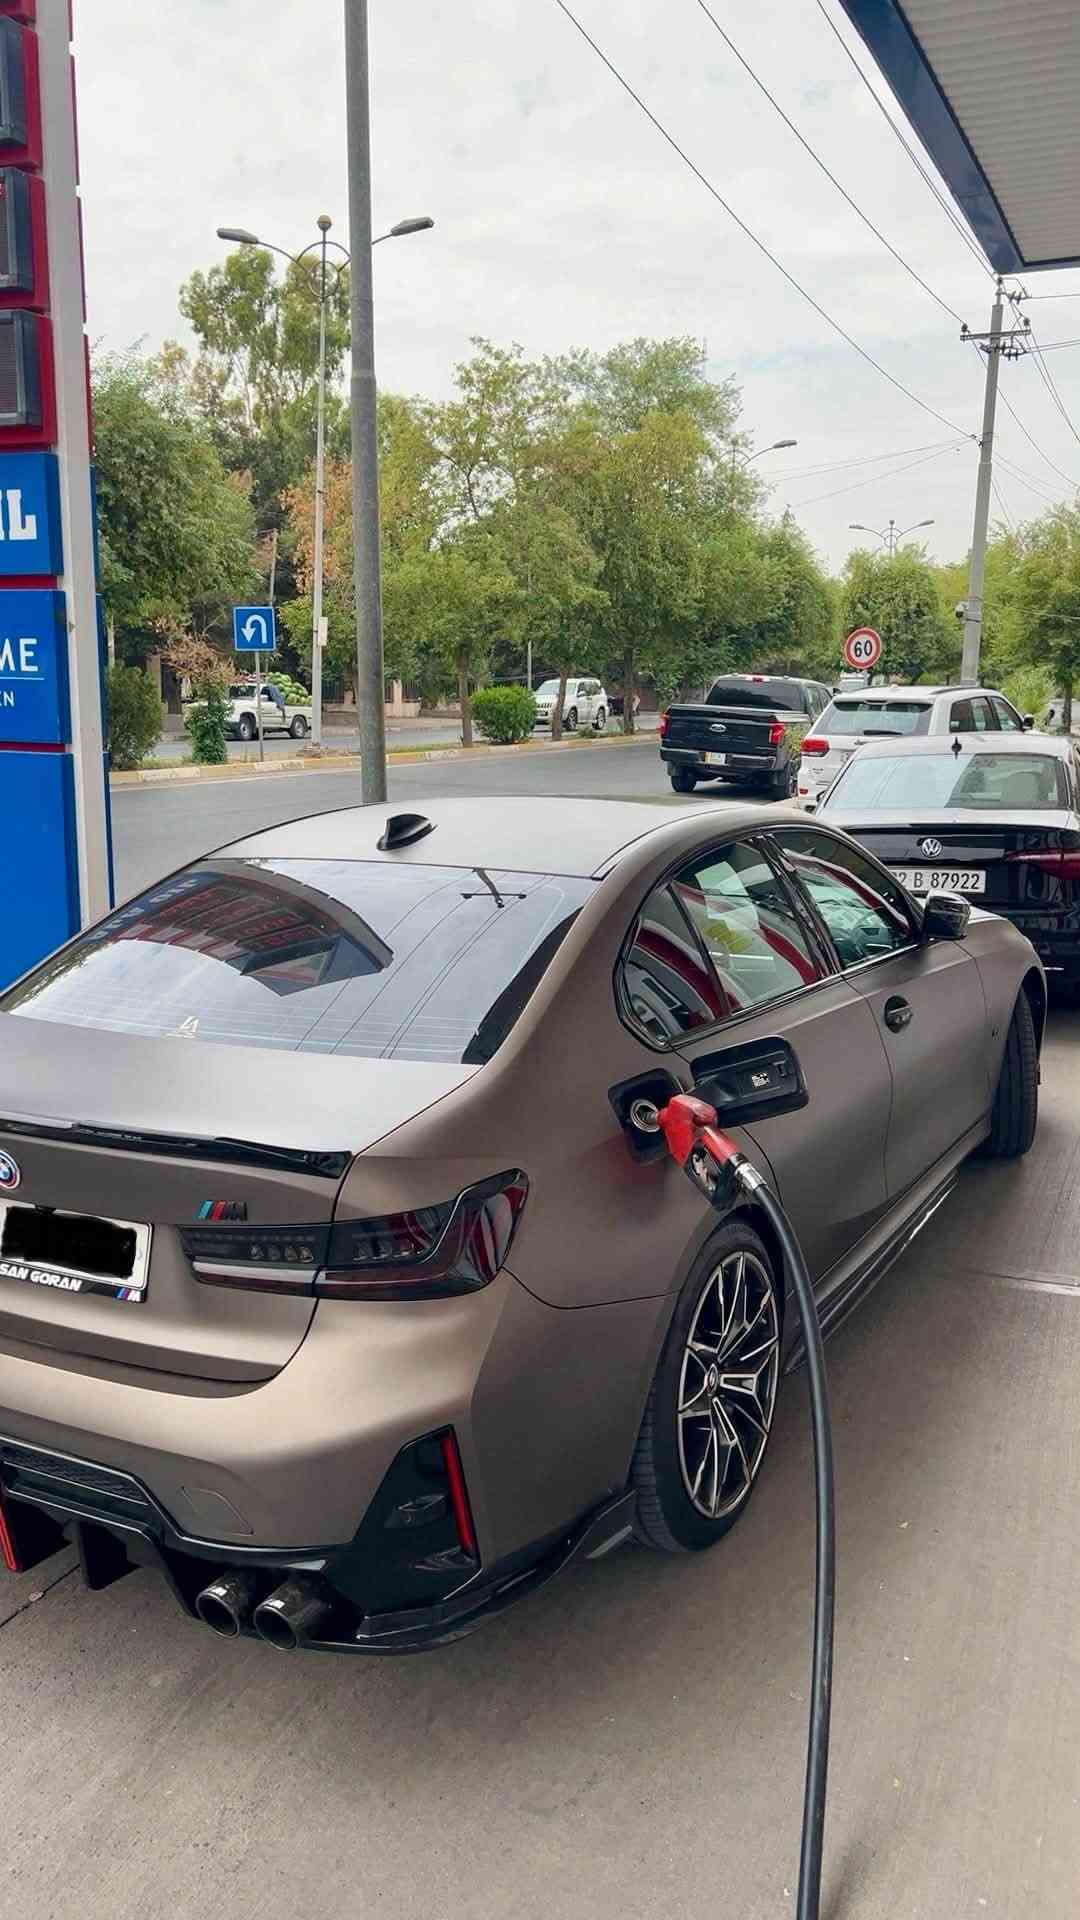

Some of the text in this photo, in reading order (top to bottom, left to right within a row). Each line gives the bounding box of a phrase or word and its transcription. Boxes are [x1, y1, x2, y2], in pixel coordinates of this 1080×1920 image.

[854, 640, 873, 657] 60
[914, 872, 924, 889] B
[930, 872, 980, 890] 87922
[30, 1270, 82, 1292] GORAN
